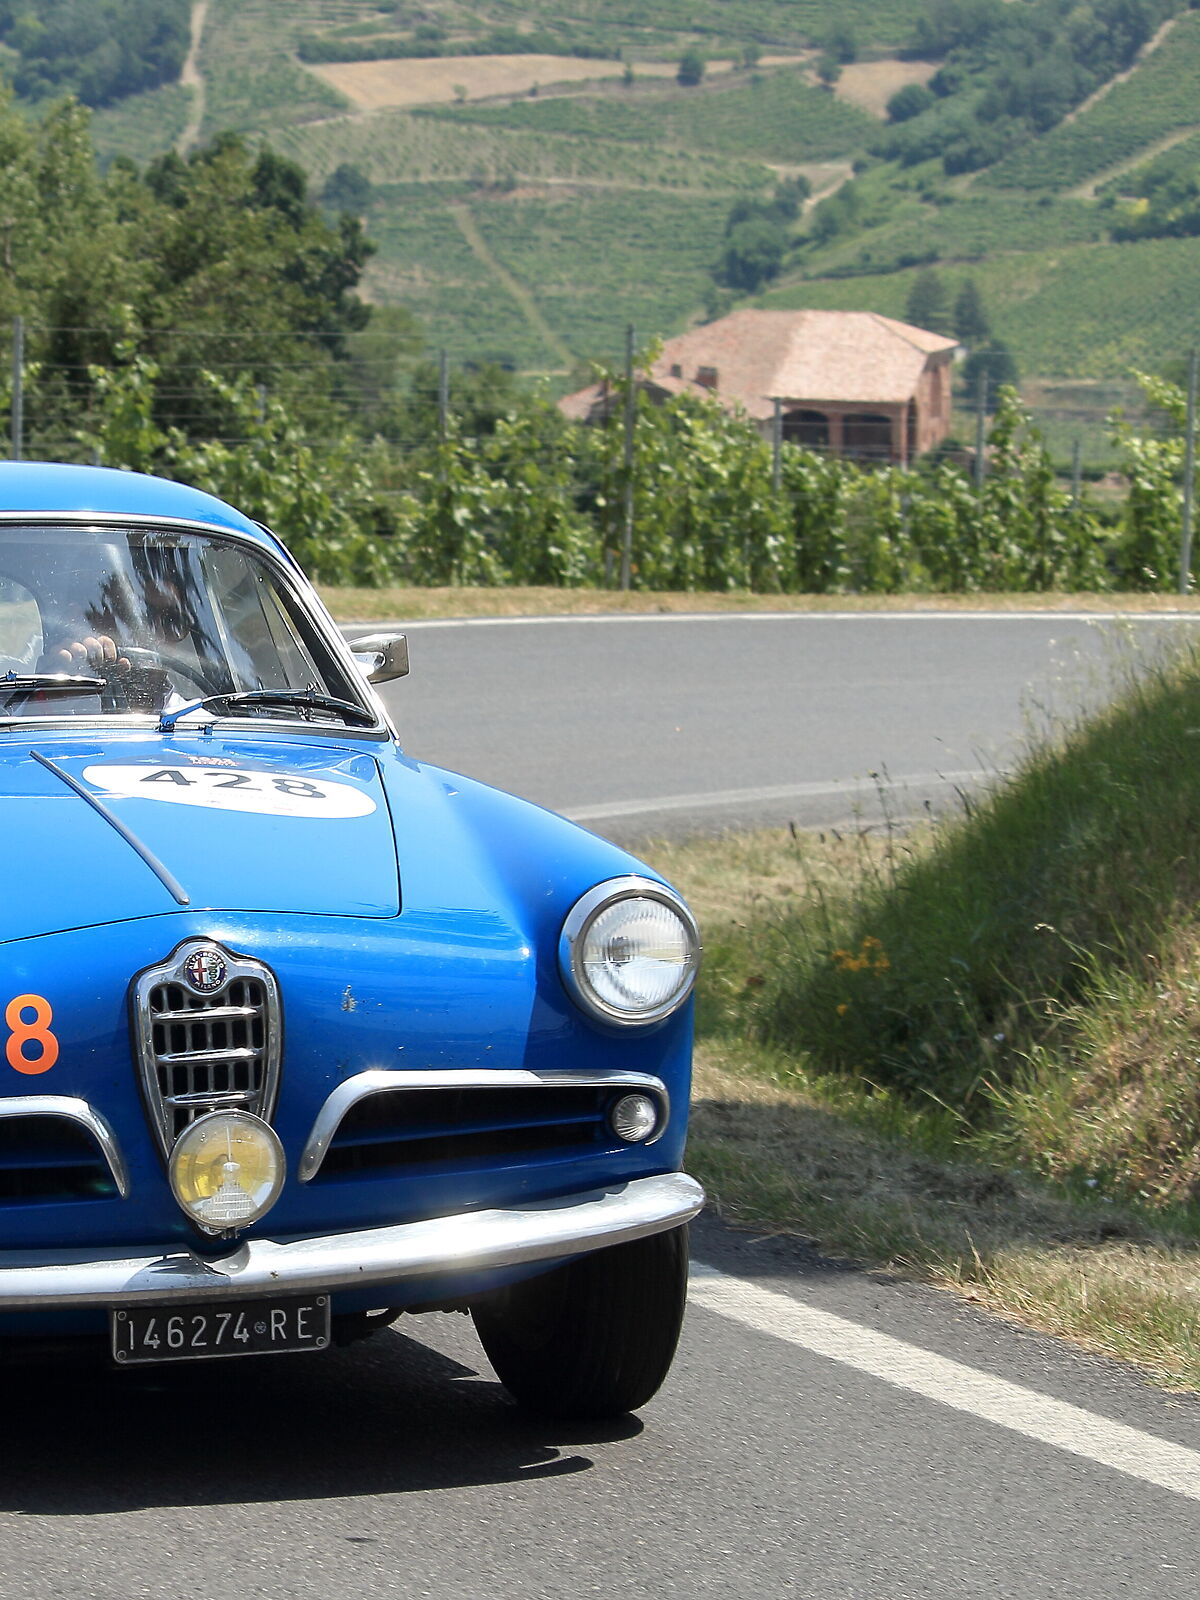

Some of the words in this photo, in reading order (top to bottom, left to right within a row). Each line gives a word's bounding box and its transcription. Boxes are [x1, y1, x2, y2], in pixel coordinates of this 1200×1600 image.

[139, 769, 327, 799] 428
[128, 1311, 250, 1350] 146274
[270, 1306, 313, 1341] RE
